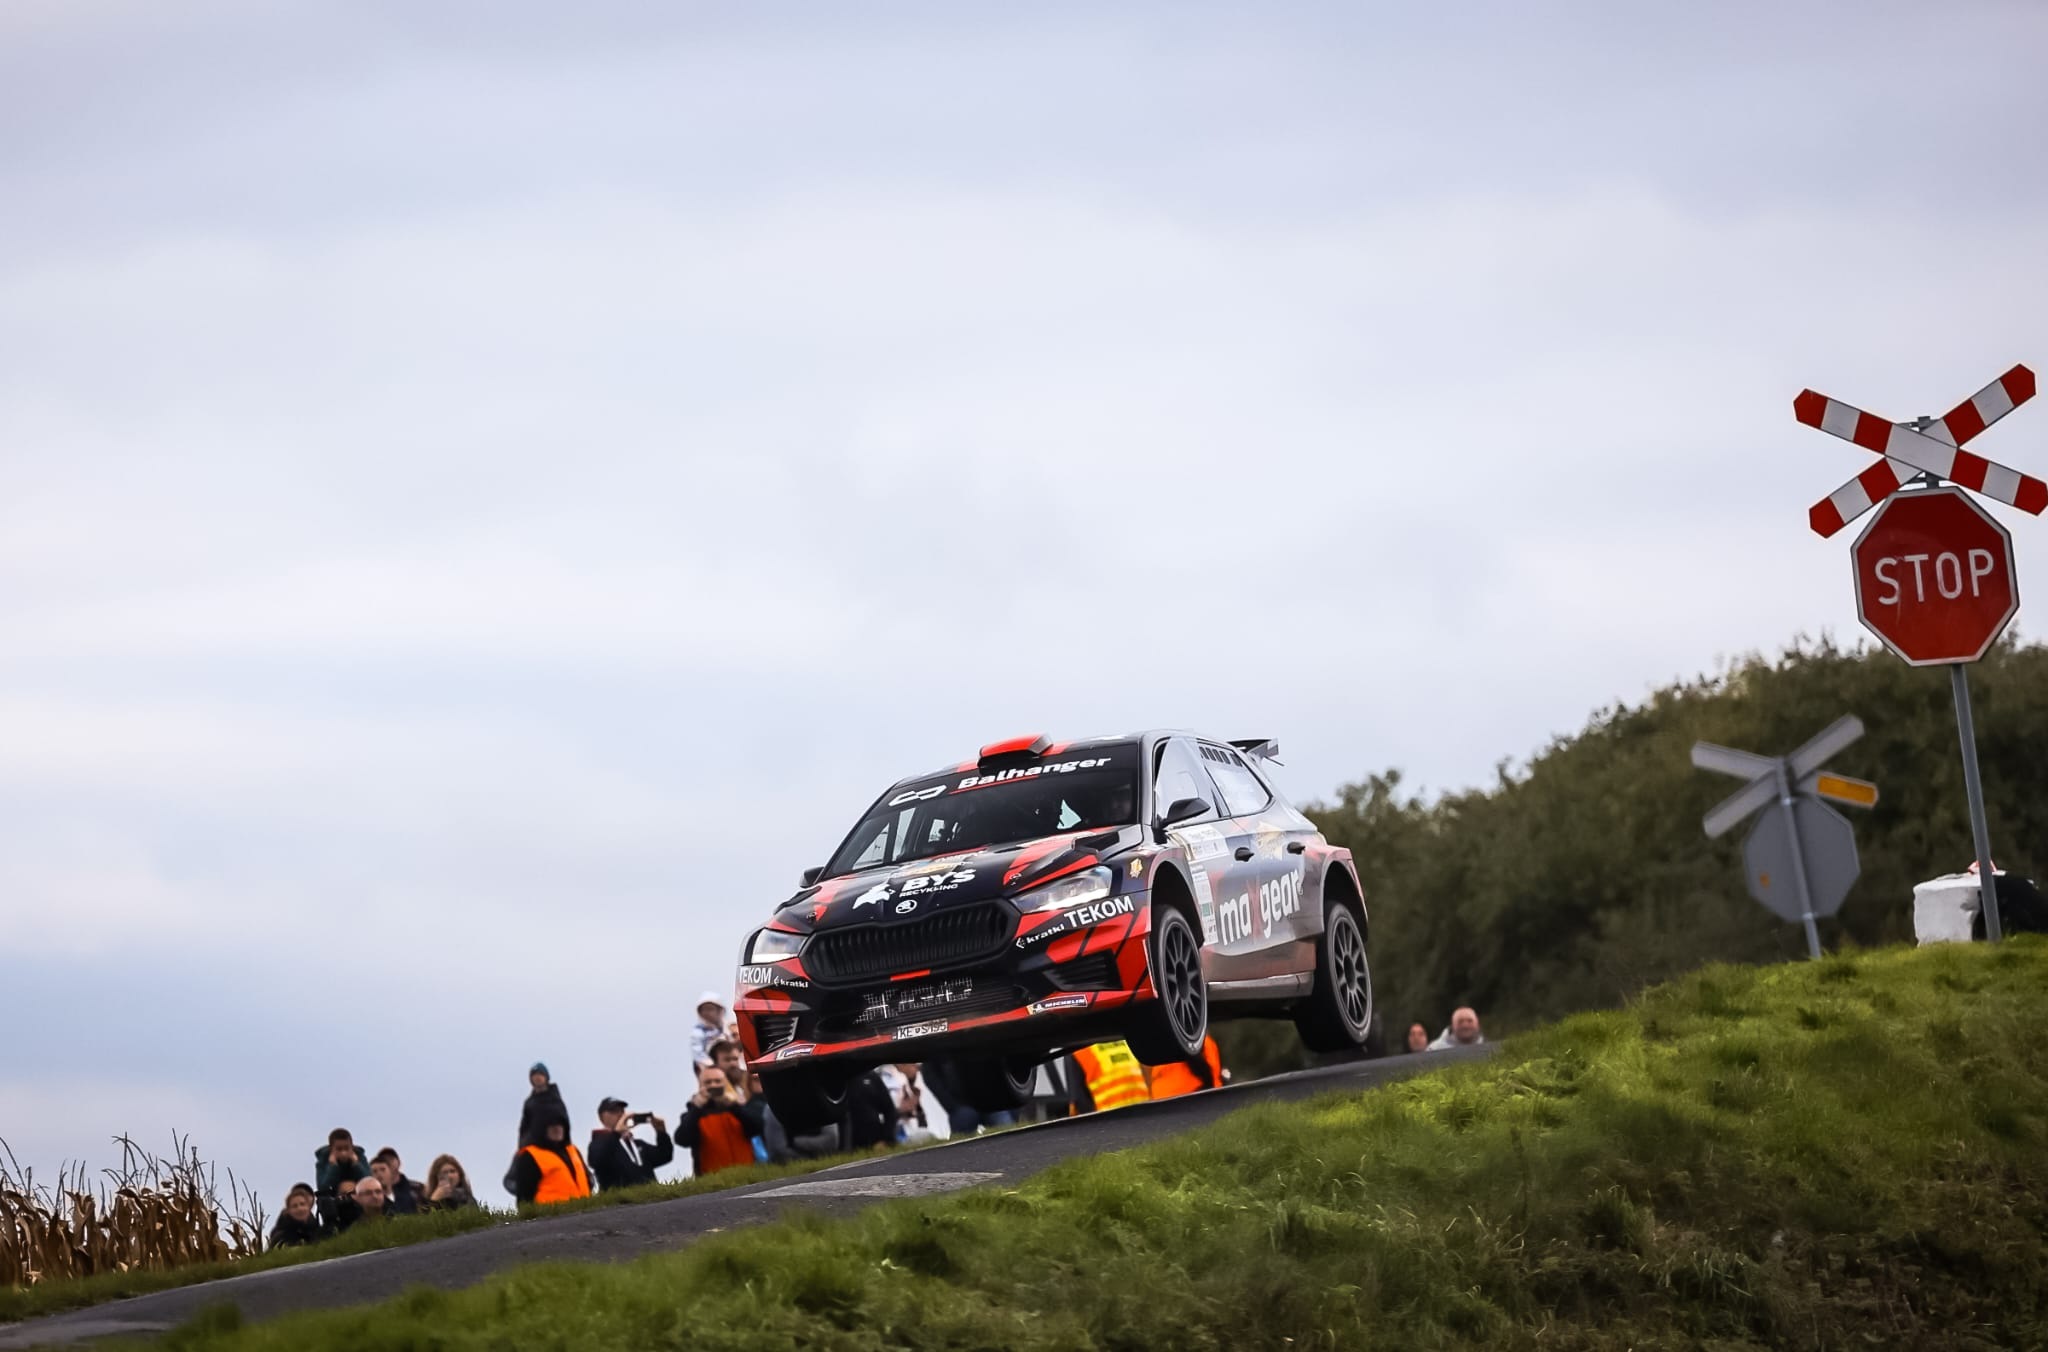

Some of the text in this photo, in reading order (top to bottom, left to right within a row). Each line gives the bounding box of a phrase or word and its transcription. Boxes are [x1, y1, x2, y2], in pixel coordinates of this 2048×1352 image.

[1875, 548, 1994, 605] STOP
[957, 757, 1112, 790] Balhanger
[899, 883, 959, 897] RECYKLING
[901, 869, 977, 892] BYS
[1026, 895, 1134, 944] kratki TEKOM
[739, 967, 809, 988] TEKOM kratki
[1045, 999, 1086, 1008] MICHELIN
